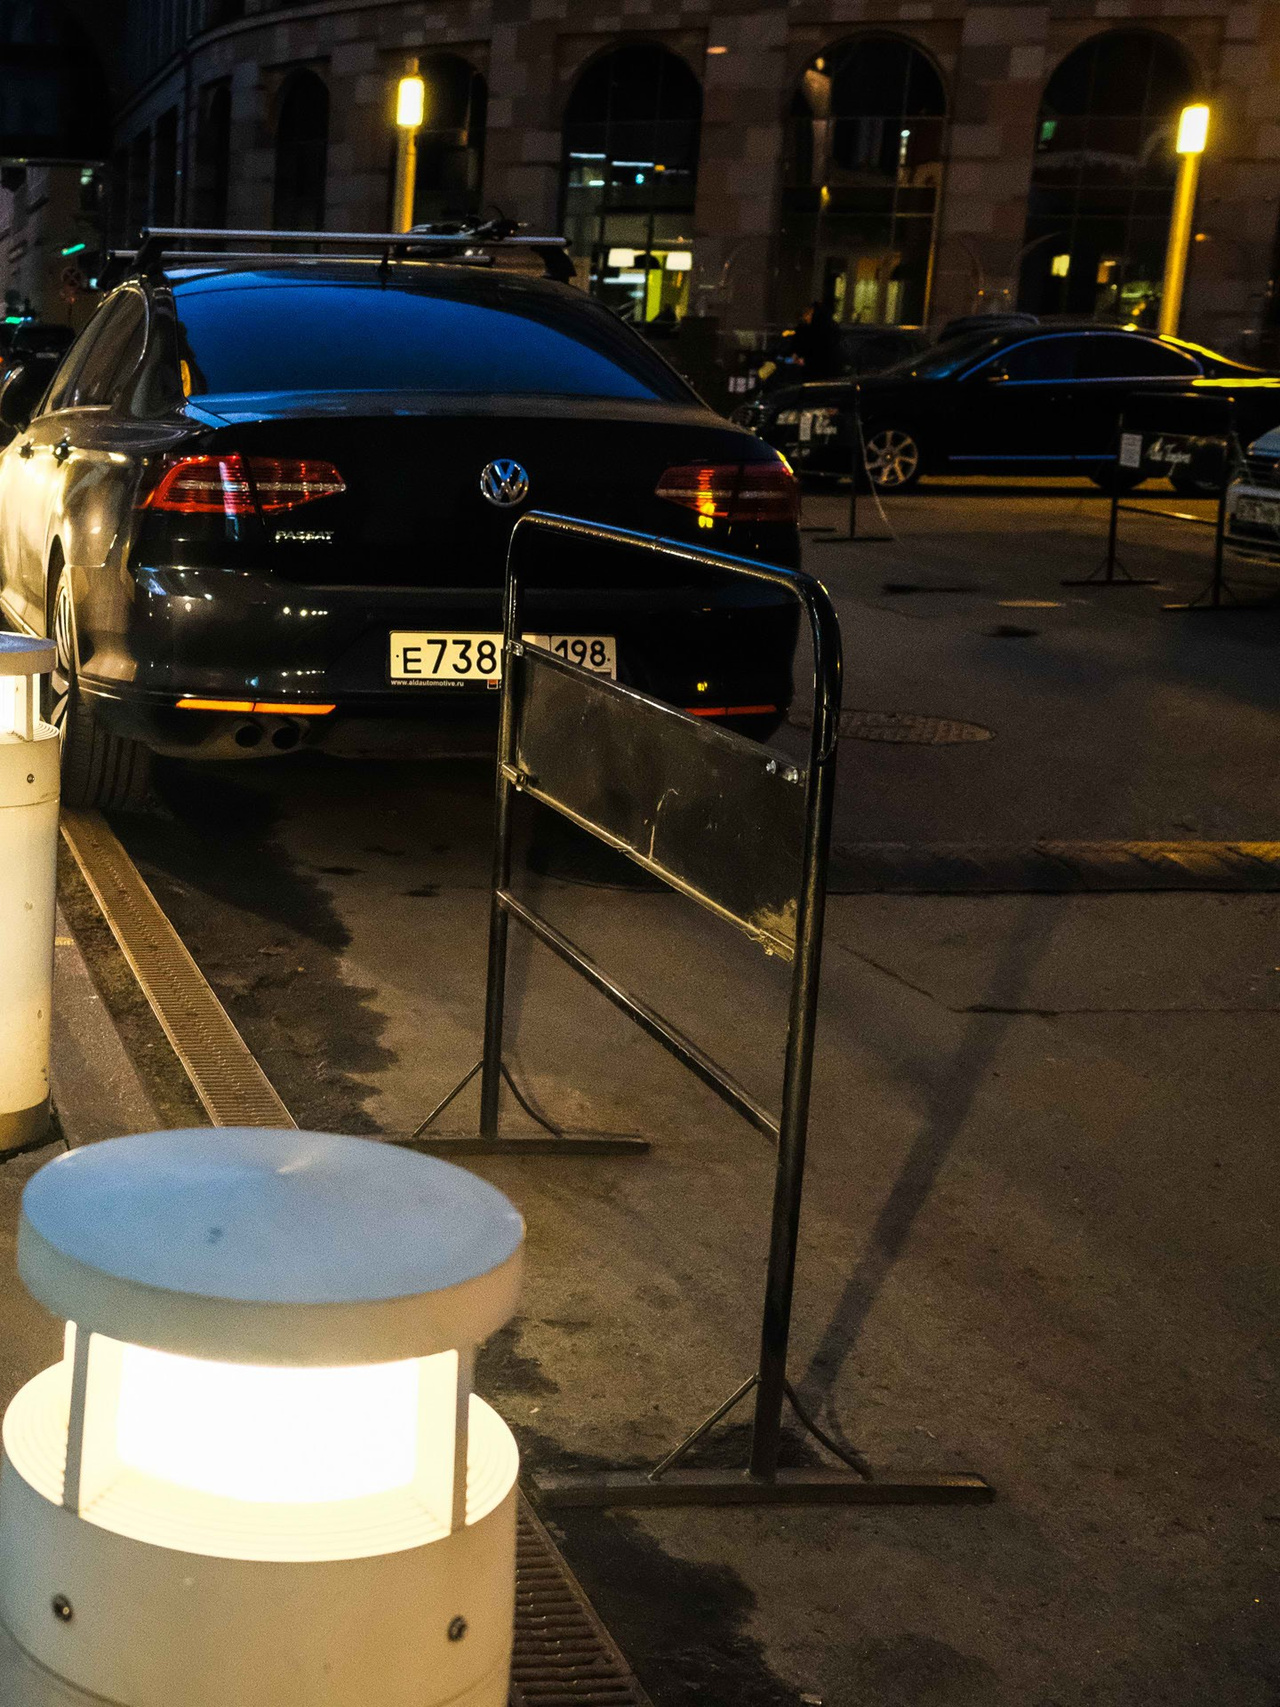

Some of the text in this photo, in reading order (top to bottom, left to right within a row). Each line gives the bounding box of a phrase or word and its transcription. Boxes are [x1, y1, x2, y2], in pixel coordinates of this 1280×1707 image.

[275, 530, 334, 541] PASSAT
[403, 639, 606, 674] E738 198
